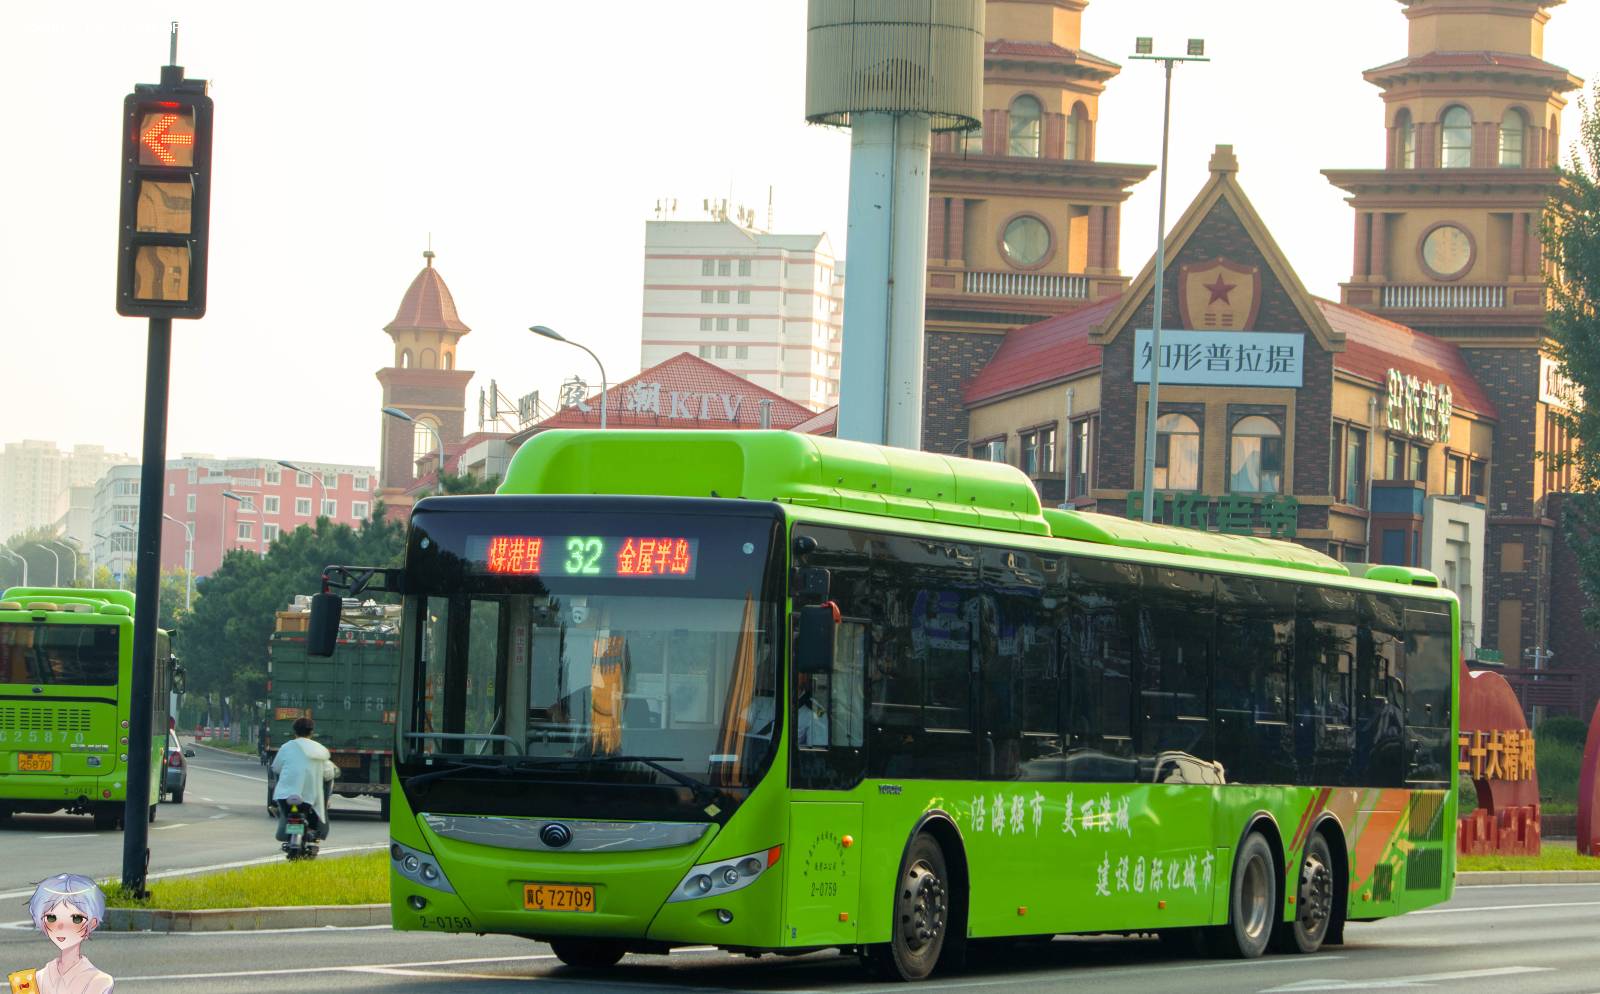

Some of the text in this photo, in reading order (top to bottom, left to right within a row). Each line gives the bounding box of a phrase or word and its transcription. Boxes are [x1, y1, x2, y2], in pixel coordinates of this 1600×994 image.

[1141, 341, 1295, 373] 知形普拉提
[669, 391, 743, 421] KTV
[490, 537, 690, 575] 煤港里 32 金屋半岛
[1458, 729, 1536, 781] 二十大精神
[971, 791, 1045, 839] 沿海强市
[1096, 851, 1215, 897] 建设国际化城市
[549, 889, 592, 908] 72709
